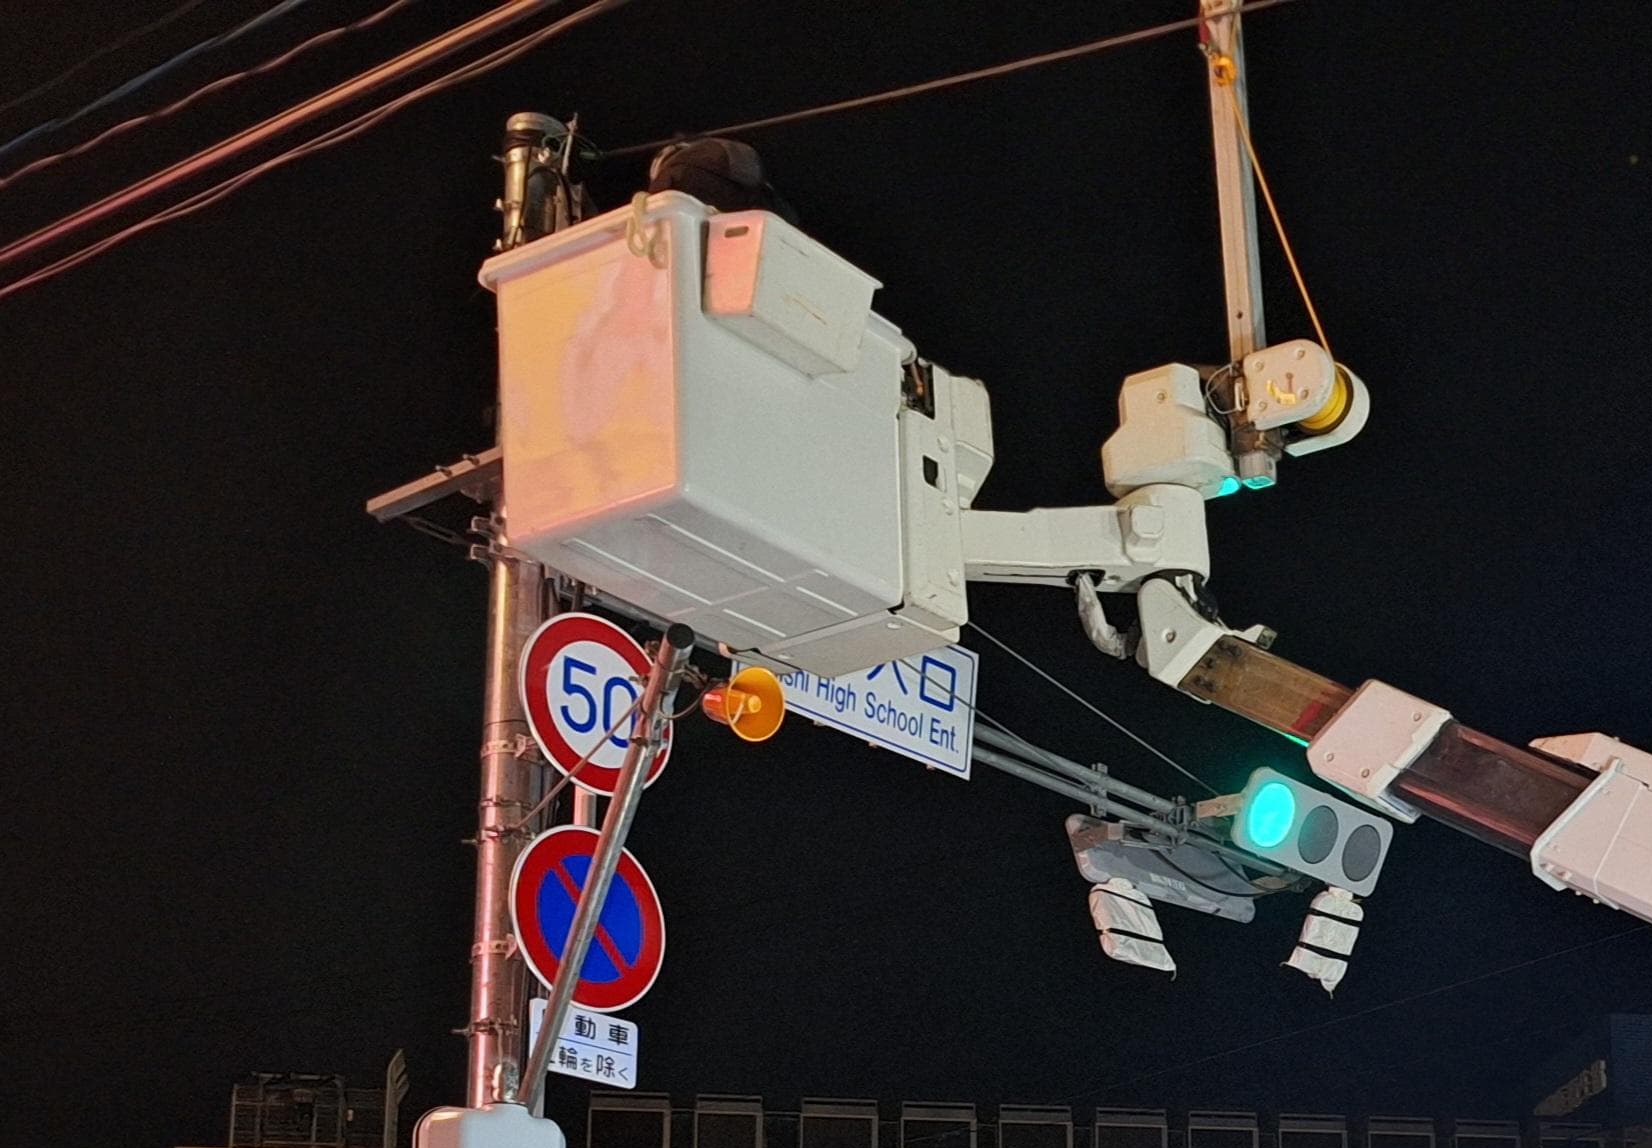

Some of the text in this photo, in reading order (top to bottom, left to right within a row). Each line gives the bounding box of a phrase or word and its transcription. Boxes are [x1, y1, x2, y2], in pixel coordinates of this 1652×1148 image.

[560, 656, 639, 749] 50
[816, 677, 857, 713] High
[864, 691, 924, 738] School
[929, 717, 959, 754] Ent.
[543, 1010, 630, 1046] 動車
